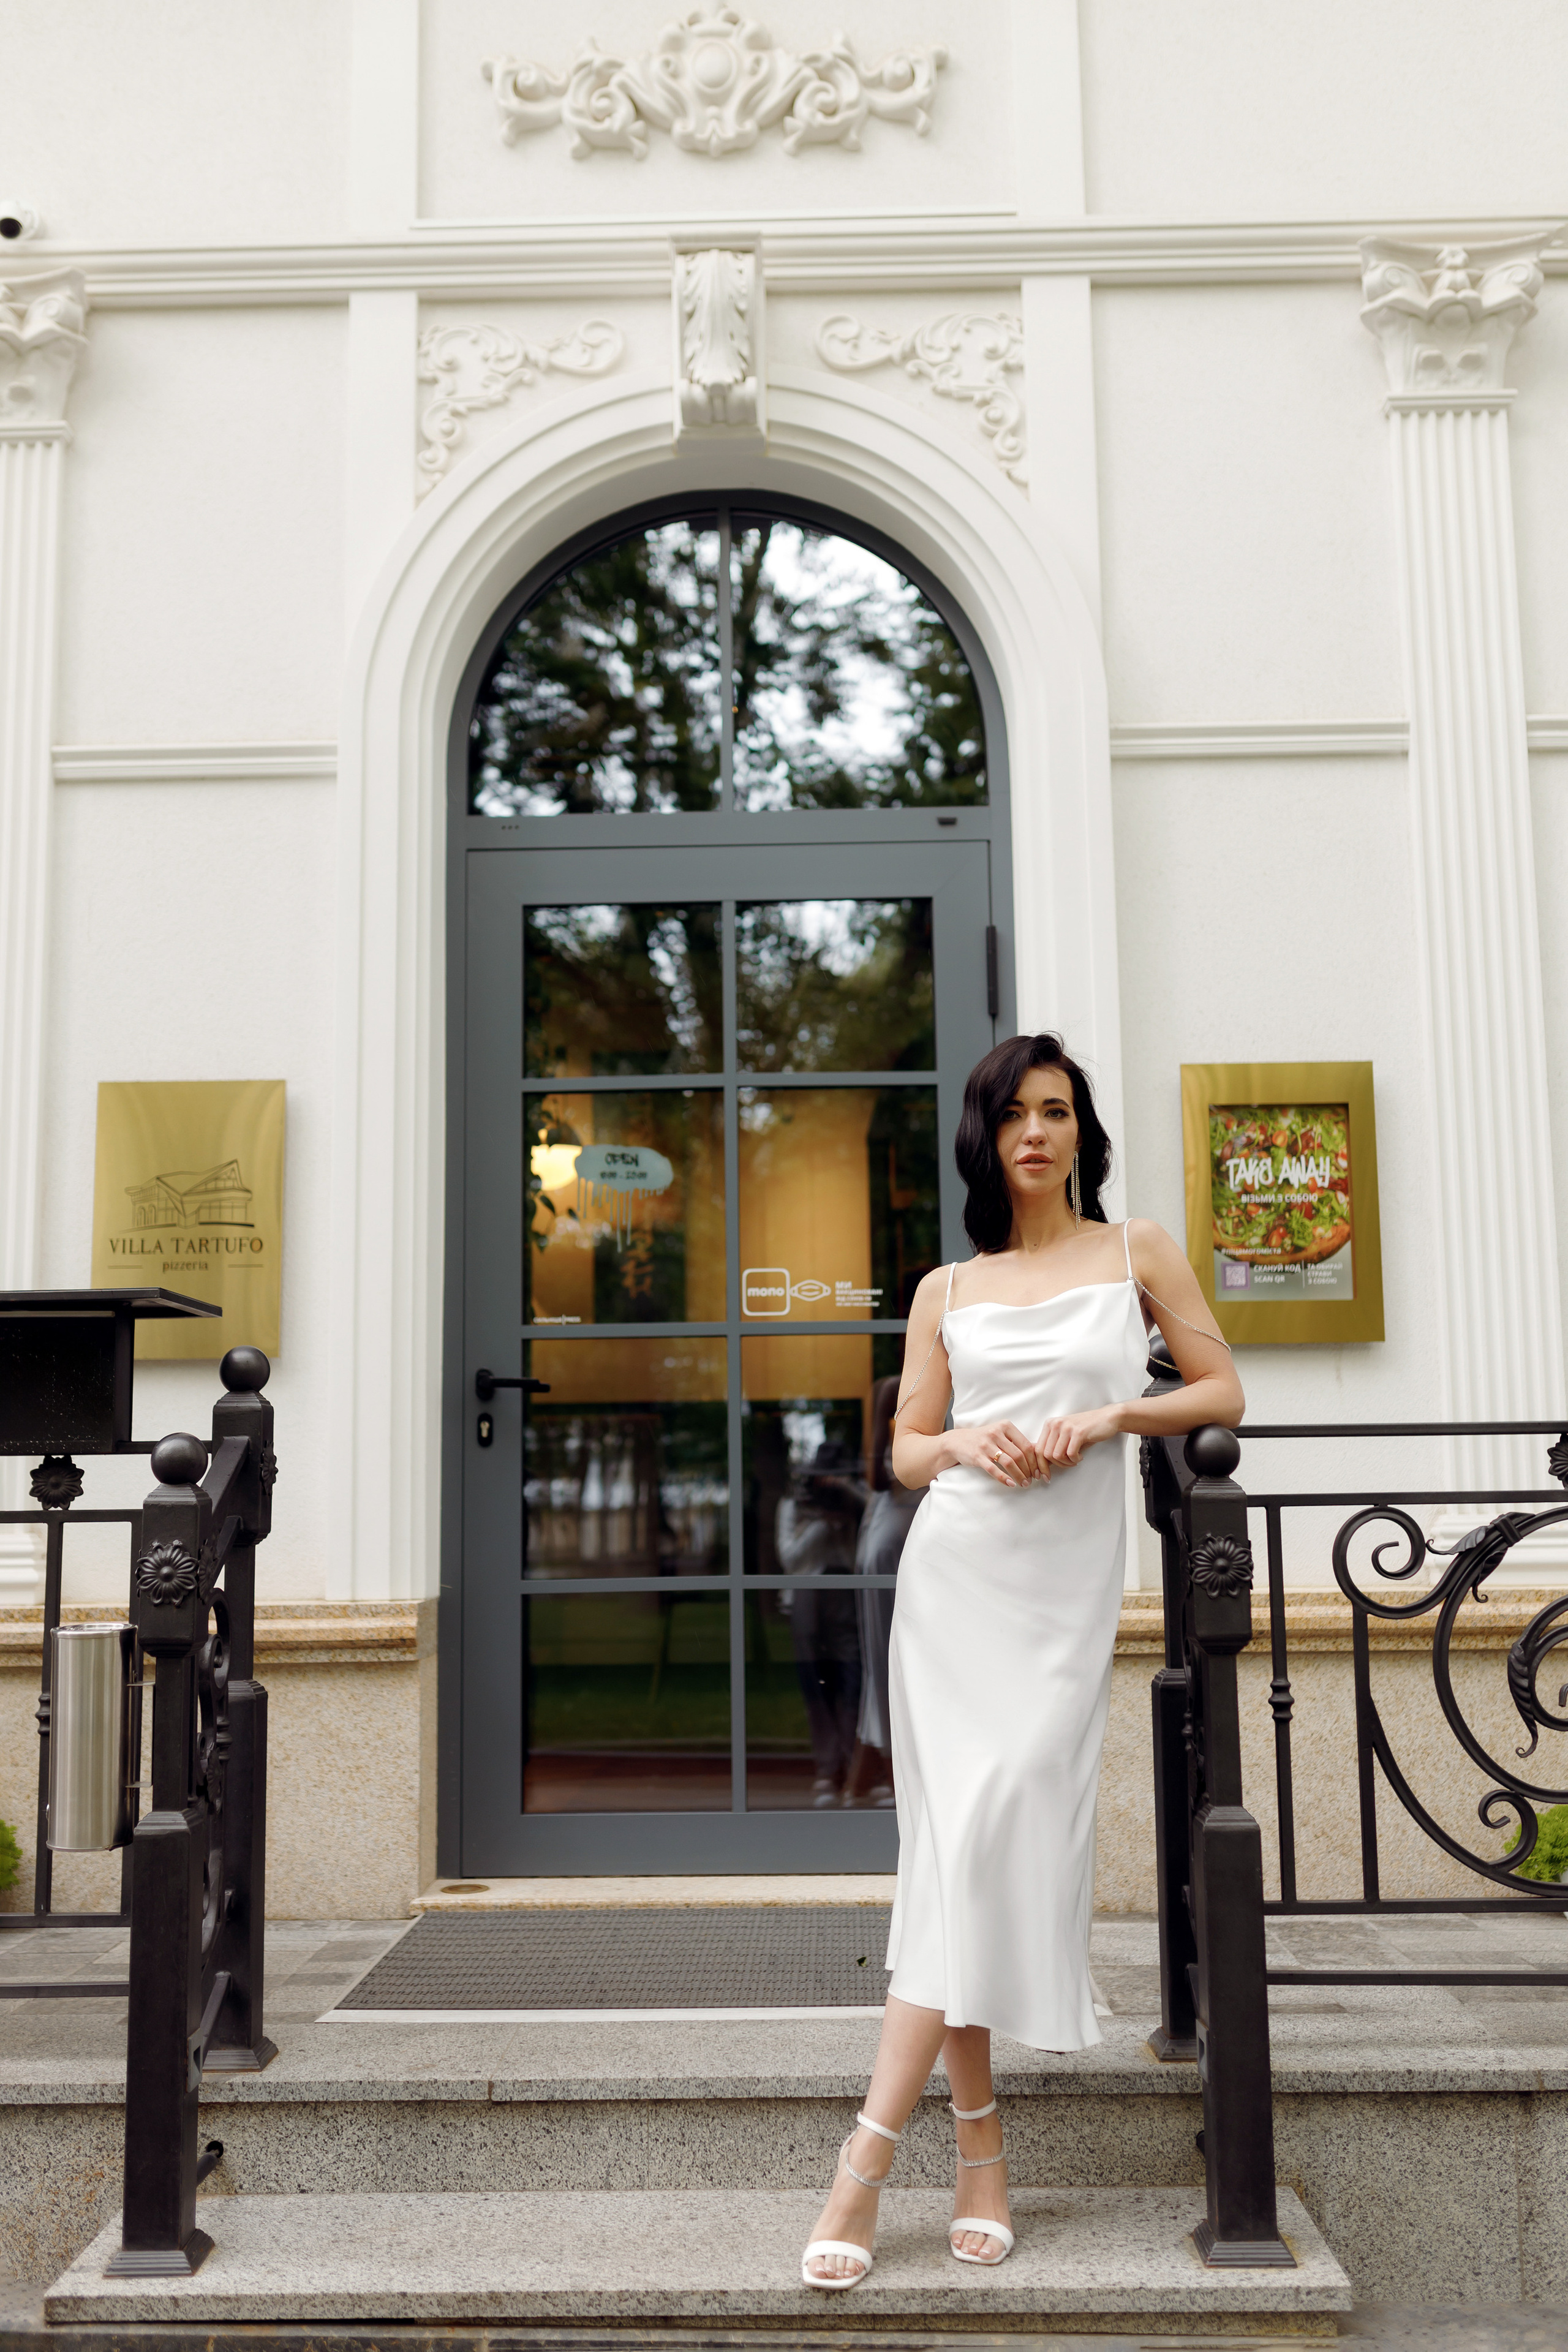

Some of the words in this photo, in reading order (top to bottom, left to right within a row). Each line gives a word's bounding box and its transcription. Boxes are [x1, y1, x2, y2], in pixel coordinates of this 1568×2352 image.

[605, 1152, 639, 1166] OPEN
[1226, 1157, 1273, 1189] TAKE
[1278, 1155, 1330, 1189] AWAY
[1241, 1194, 1275, 1204] ВІЗЬМИ
[1285, 1193, 1318, 1203] СОБОЮ
[109, 1237, 164, 1254] VILLA
[170, 1237, 263, 1254] TARTUFO
[162, 1261, 209, 1274] pizzeria
[1254, 1262, 1283, 1273] СКАНУЙ
[1285, 1264, 1302, 1273] КОД
[1254, 1275, 1273, 1284] SCAN
[747, 1287, 785, 1297] mono
